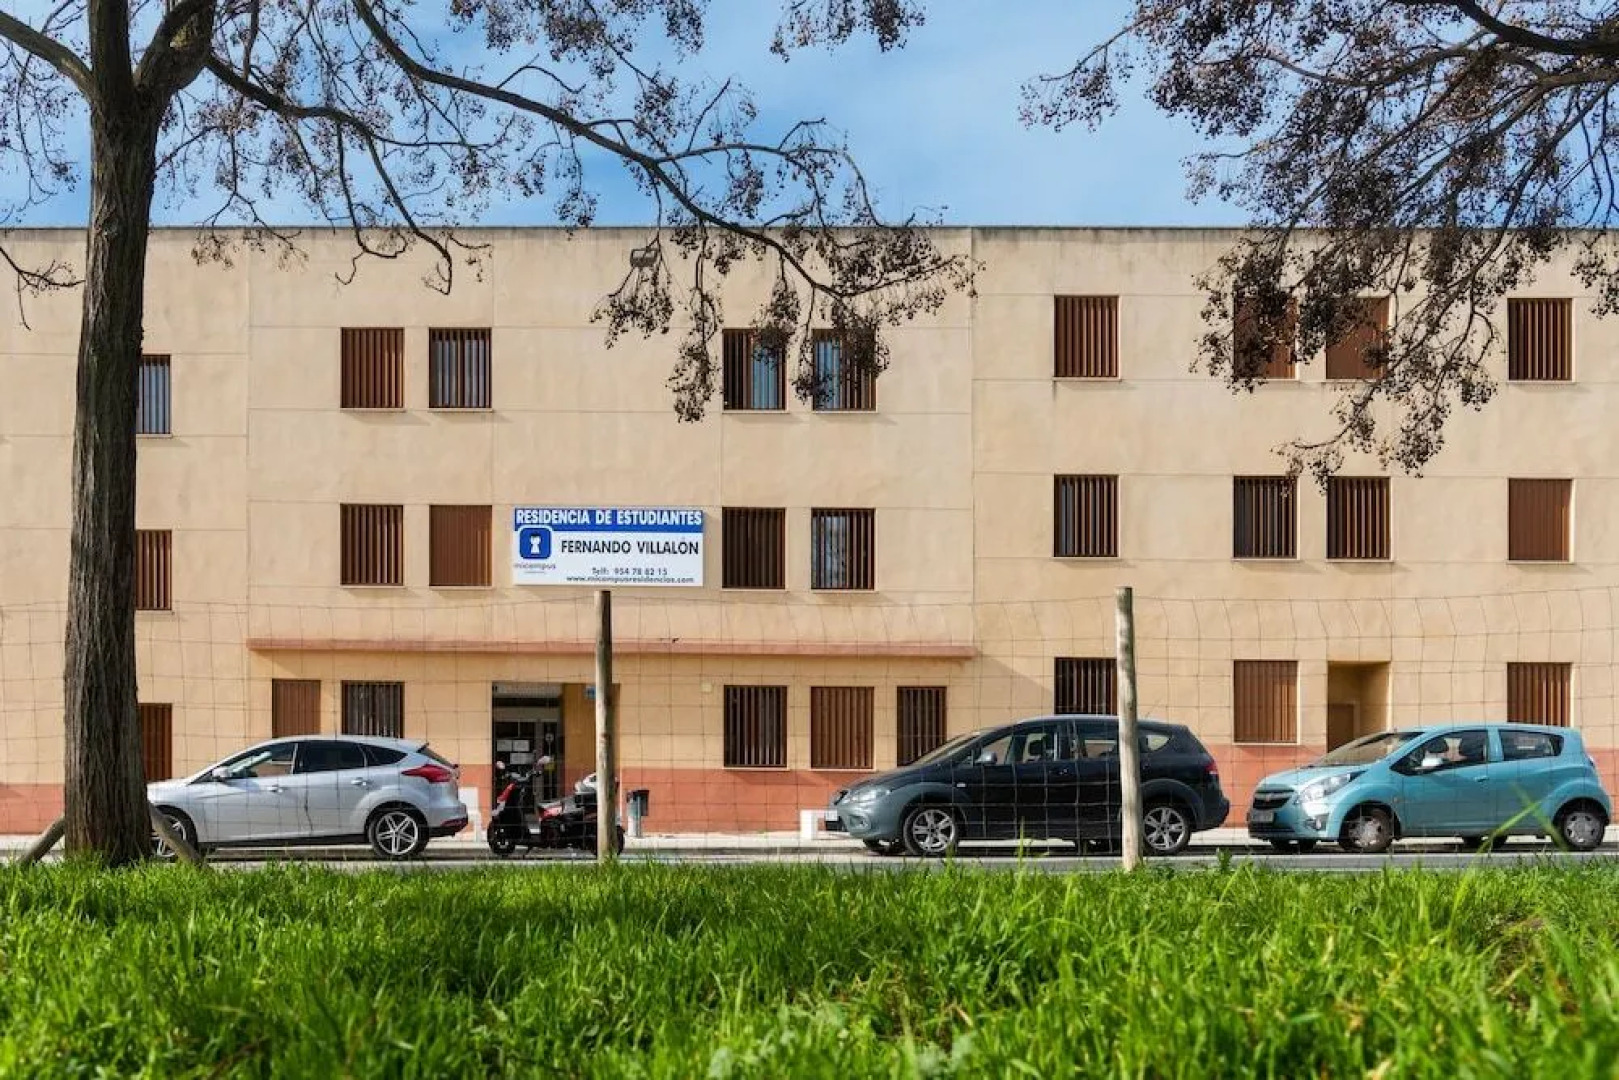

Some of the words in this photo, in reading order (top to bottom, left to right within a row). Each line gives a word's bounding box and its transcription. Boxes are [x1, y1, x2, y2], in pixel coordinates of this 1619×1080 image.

[516, 510, 590, 524] RESIDENCIA
[595, 510, 613, 524] DE
[617, 510, 702, 525] ESTUDIANTES
[561, 540, 632, 553] FERNANDO
[614, 567, 629, 575] 954
